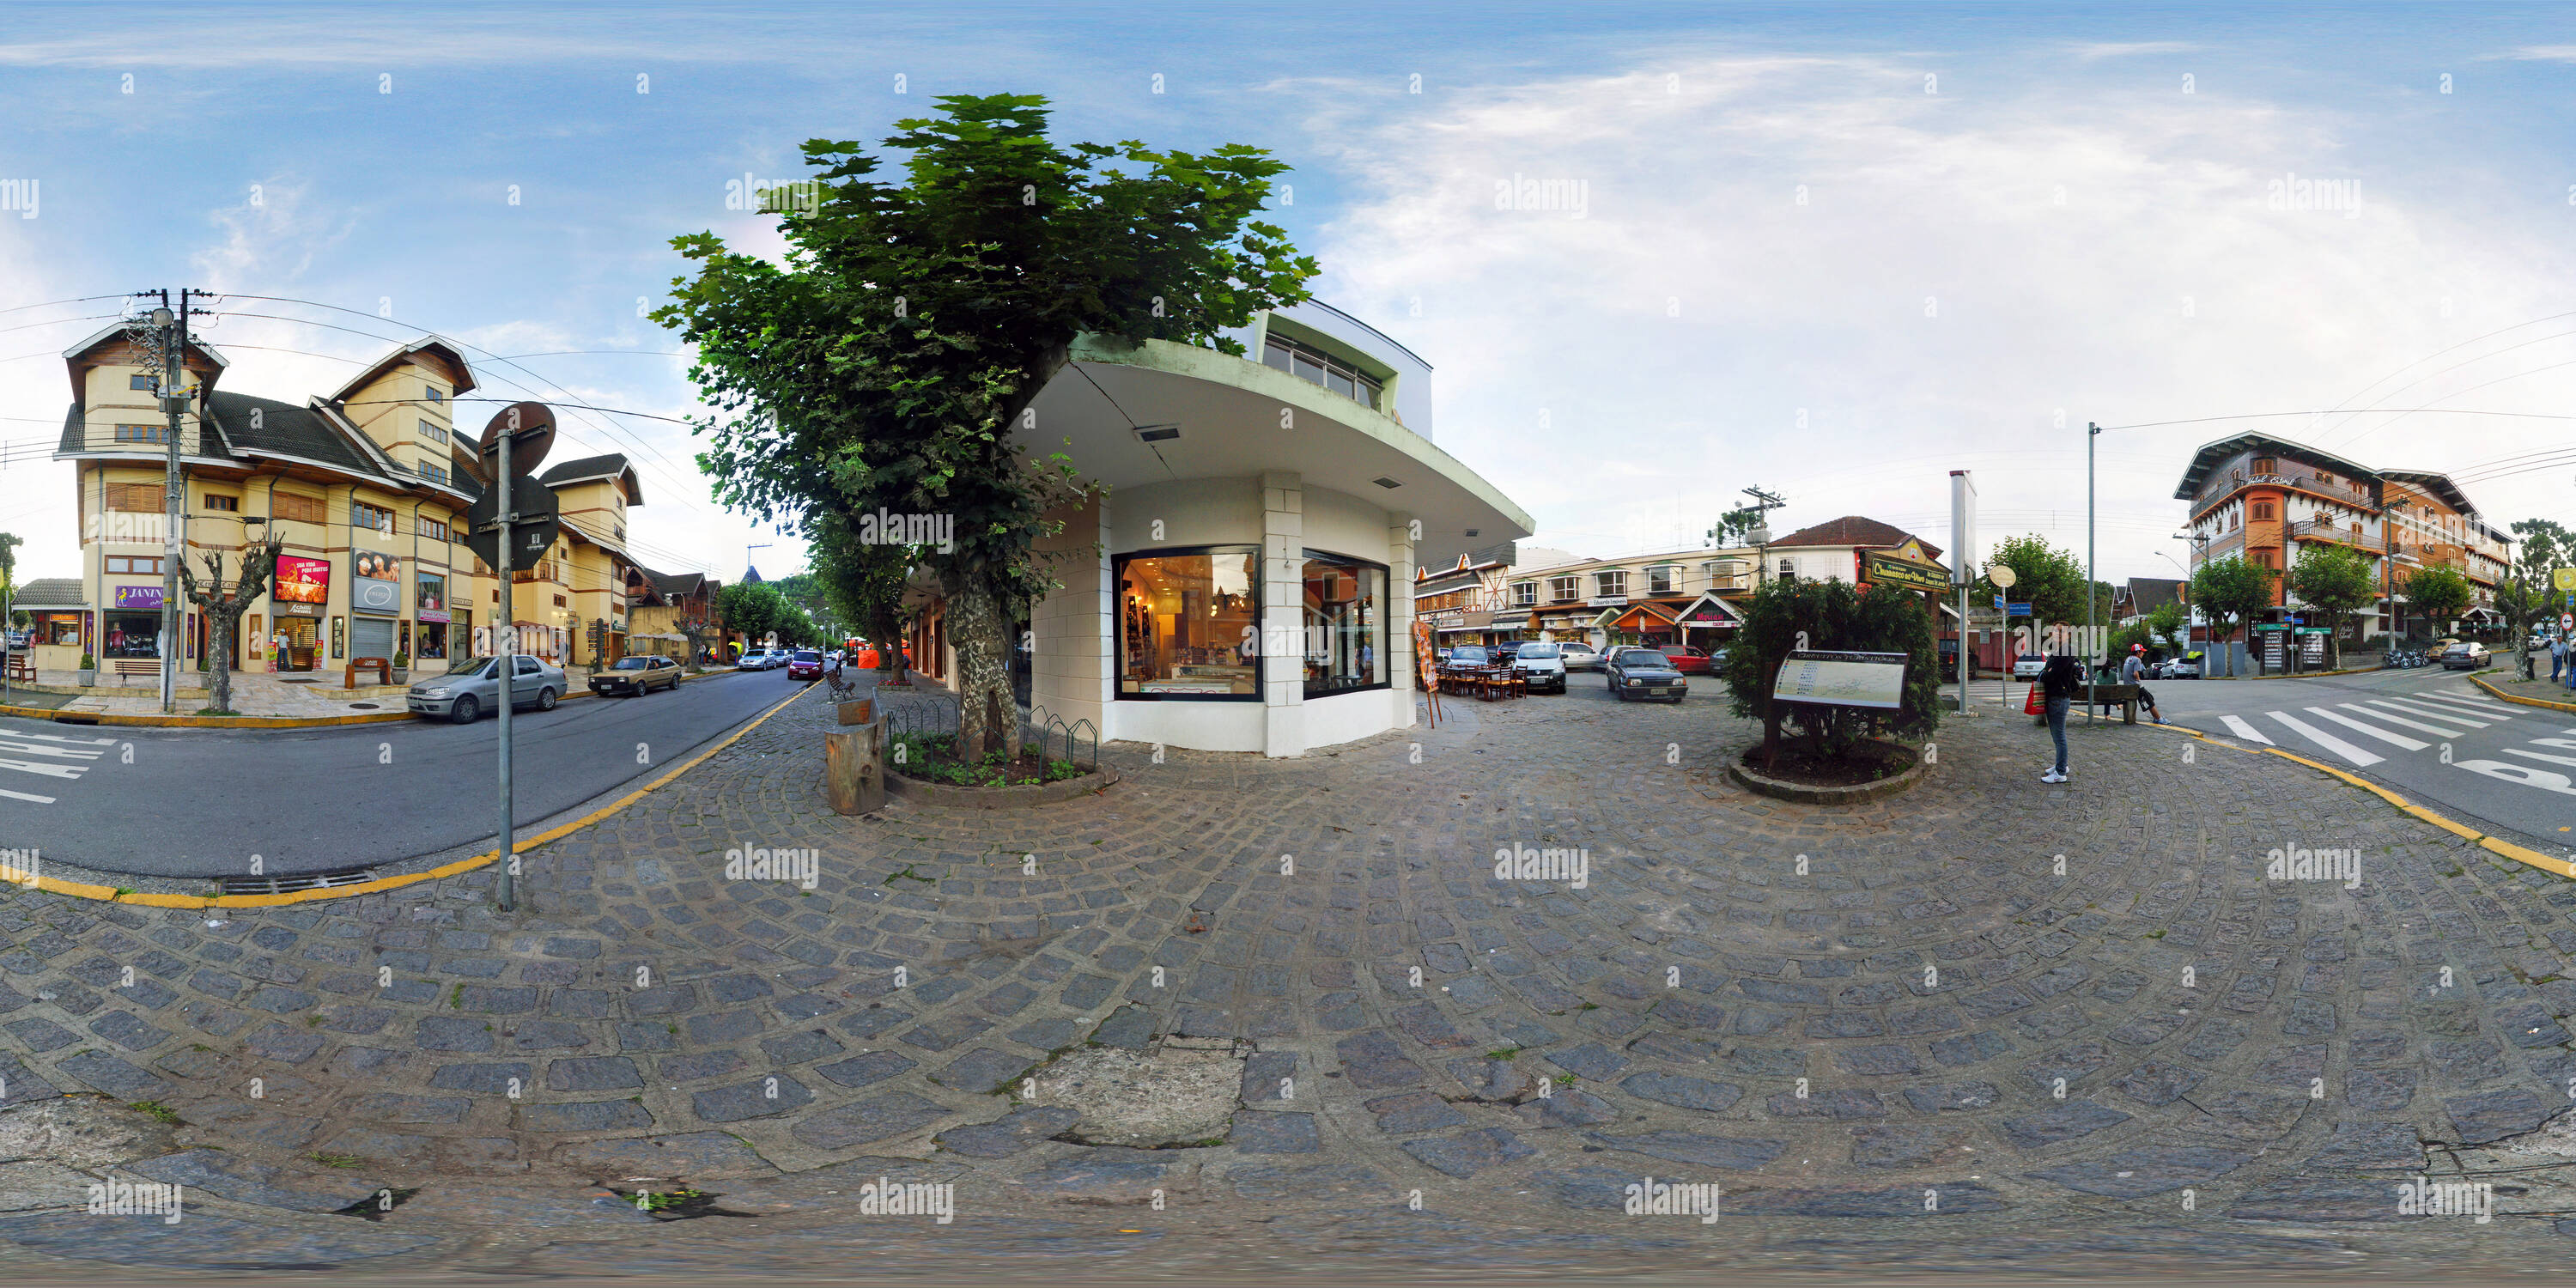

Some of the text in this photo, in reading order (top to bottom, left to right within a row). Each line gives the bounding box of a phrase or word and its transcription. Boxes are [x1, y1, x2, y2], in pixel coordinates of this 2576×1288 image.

[2247, 475, 2295, 486] Hotel Estoril
[129, 588, 163, 598] JANIN
